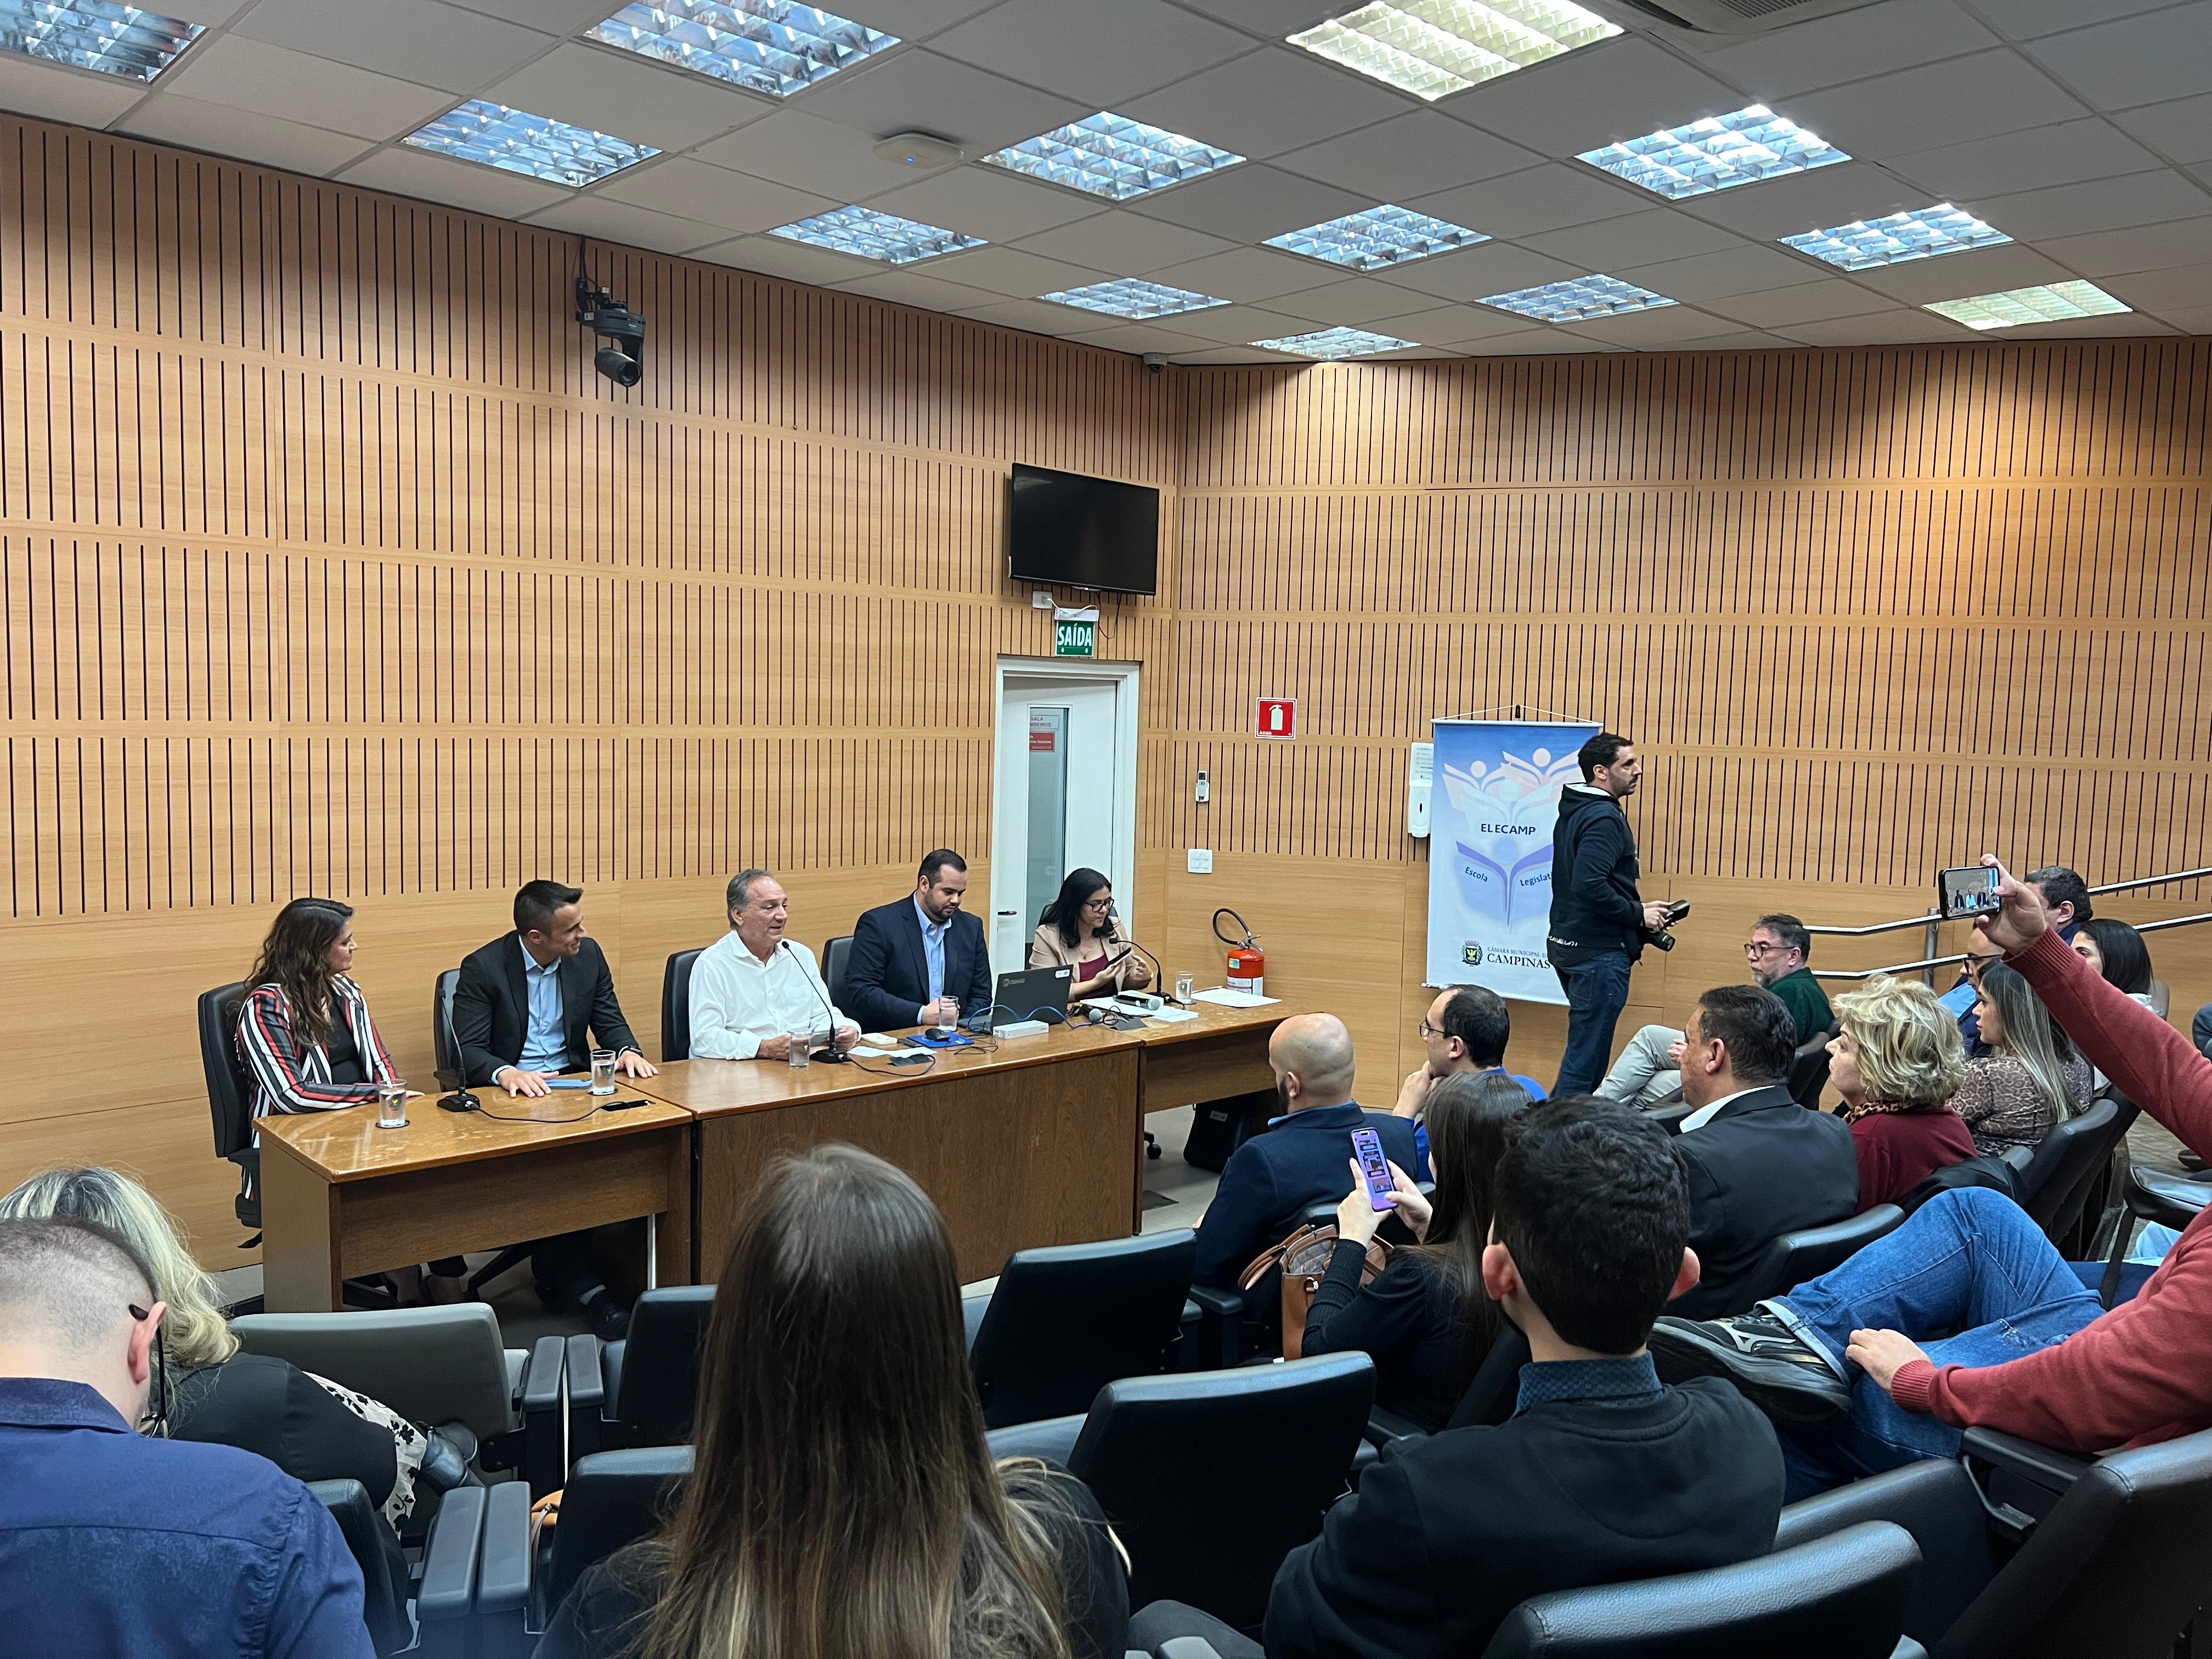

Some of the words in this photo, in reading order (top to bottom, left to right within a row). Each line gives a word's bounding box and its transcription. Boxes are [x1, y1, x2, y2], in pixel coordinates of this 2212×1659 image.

[1058, 623, 1092, 647] SAÍDA
[1481, 823, 1536, 835] ELECAMP
[1465, 866, 1488, 882] Escola
[1487, 953, 1550, 969] CAMPINAS
[1510, 949, 1541, 957] MUNICIPAL
